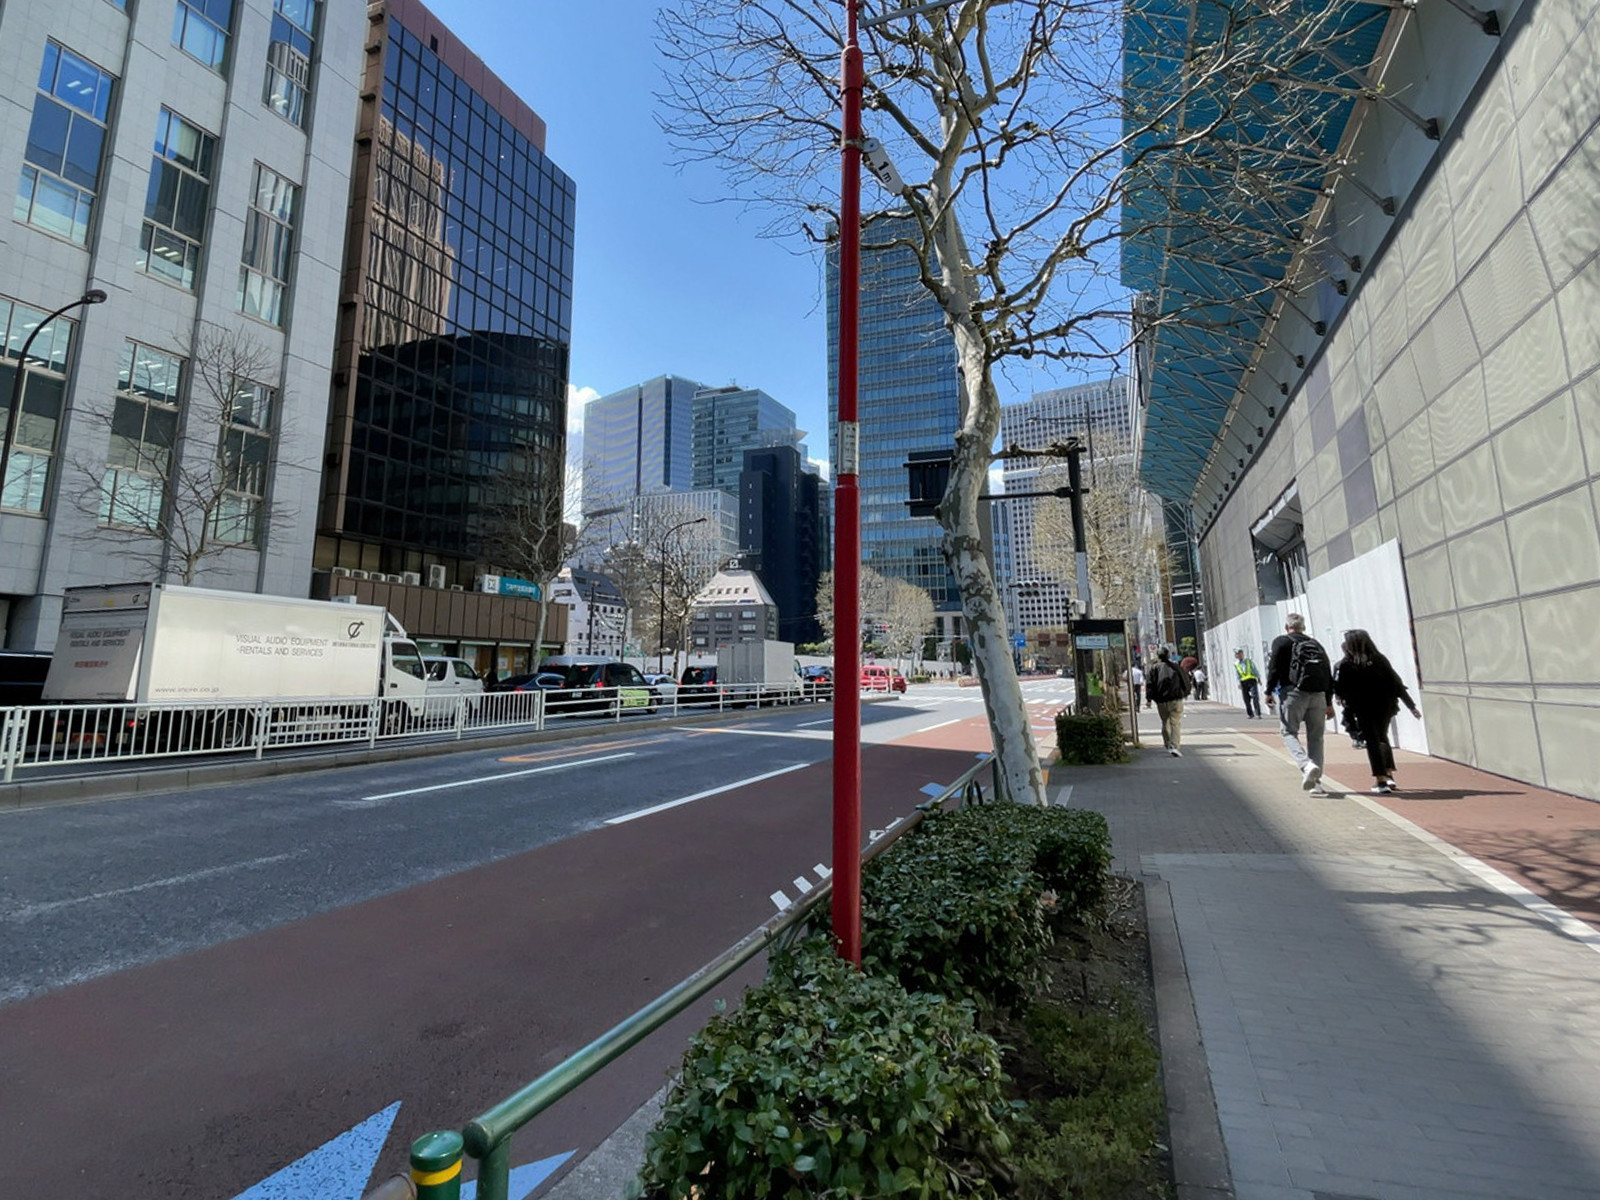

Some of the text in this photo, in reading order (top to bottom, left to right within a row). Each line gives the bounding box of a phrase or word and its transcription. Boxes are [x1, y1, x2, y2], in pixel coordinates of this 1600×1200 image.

[236, 634, 328, 647] VISUAL AUDIO EQUIPMENT
[274, 647, 289, 656] AND
[291, 648, 324, 657] SERVICES
